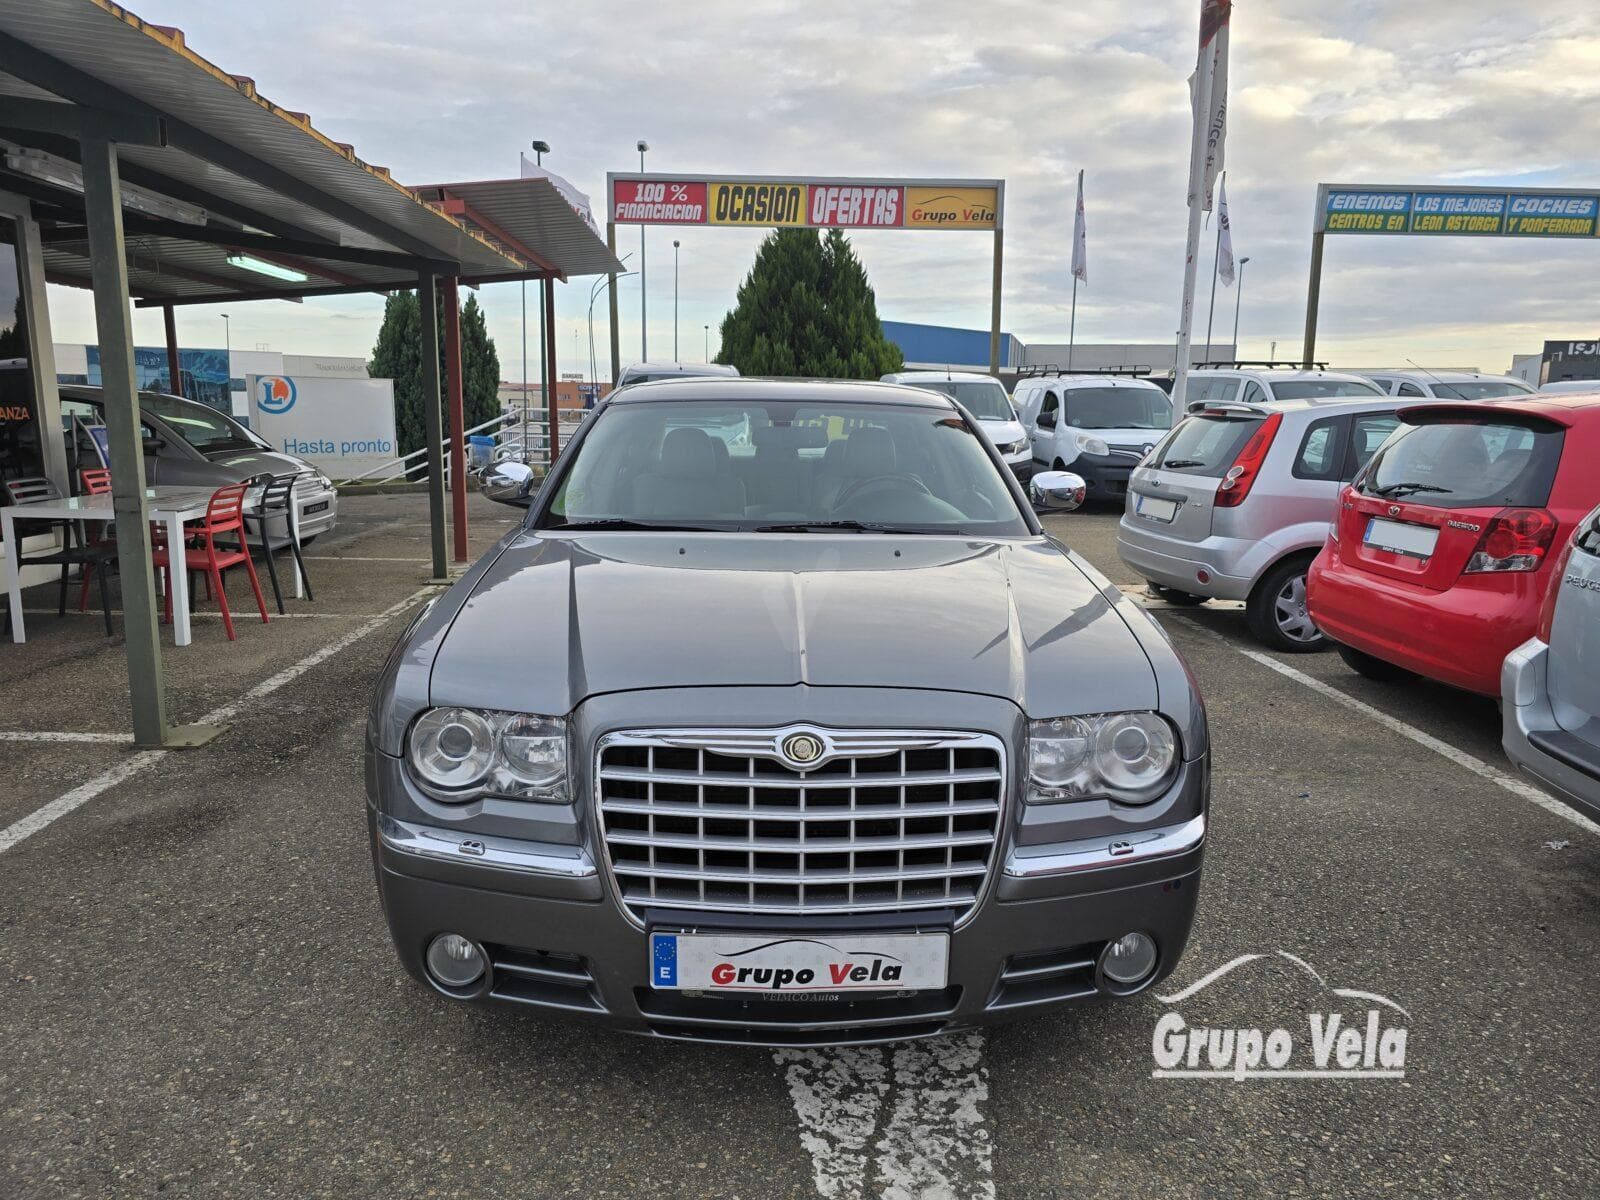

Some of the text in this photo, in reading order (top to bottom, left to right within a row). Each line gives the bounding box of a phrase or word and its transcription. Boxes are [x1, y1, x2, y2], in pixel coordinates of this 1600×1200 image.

[634, 183, 666, 203] 100
[615, 202, 703, 220] FINANCIACION
[715, 185, 801, 222] OCASION
[812, 187, 899, 225] OFERTAS
[1414, 196, 1504, 213] LOS MEJORES
[1511, 198, 1593, 214] COCHES
[911, 209, 996, 223] Grupo Vela
[1328, 213, 1405, 231] CENTROS EN
[1413, 215, 1500, 231] LEON ASTORGA
[1508, 217, 1592, 234] Y PONFERRADA
[0, 406, 30, 420] ANZA
[284, 438, 391, 457] Hasta pronto
[660, 966, 671, 979] E
[711, 959, 903, 989] Grupo Vela
